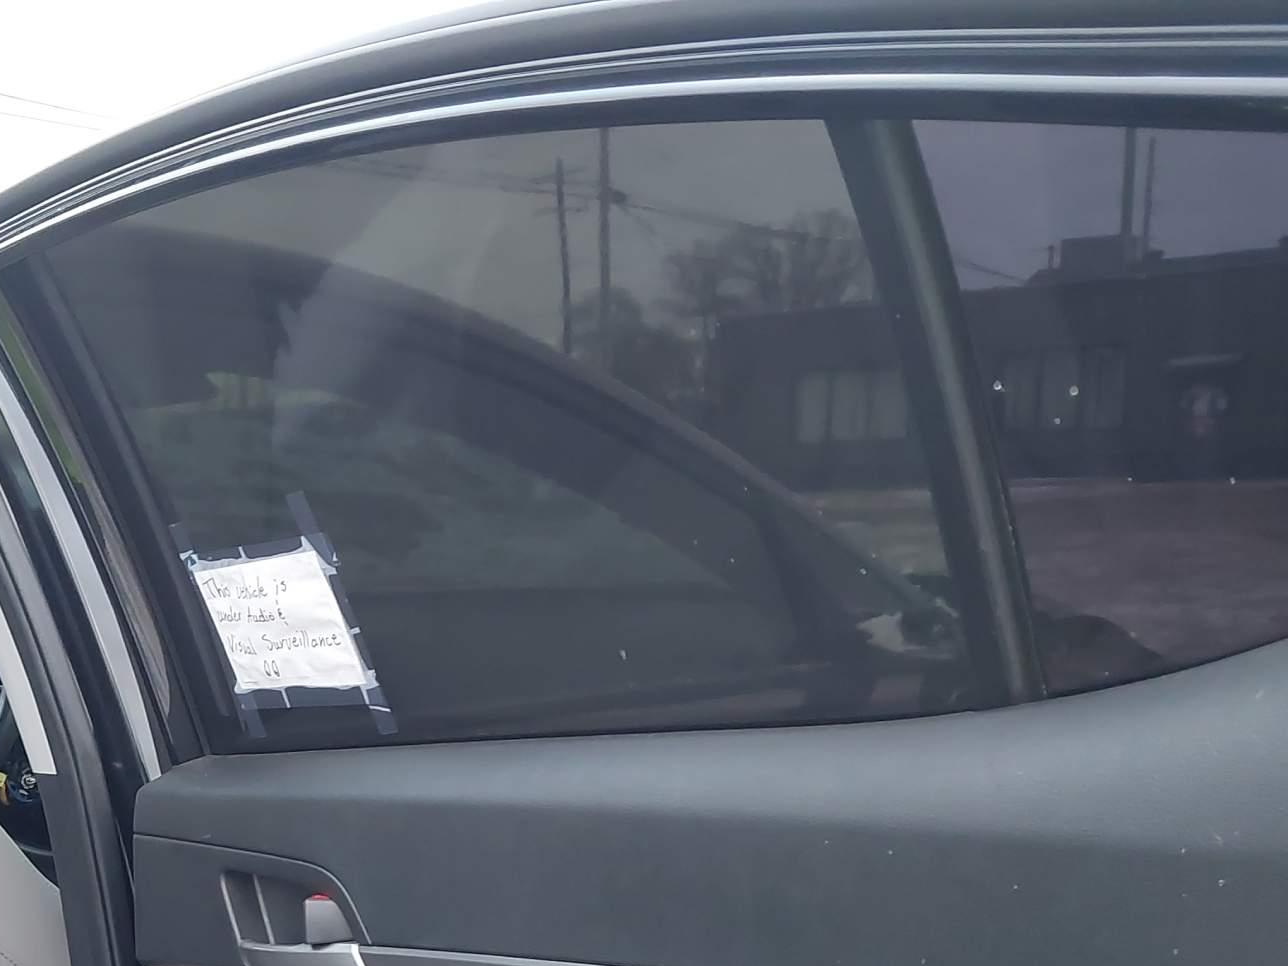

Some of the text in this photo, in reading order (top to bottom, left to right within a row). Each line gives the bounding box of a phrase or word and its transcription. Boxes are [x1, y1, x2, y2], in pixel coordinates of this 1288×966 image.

[202, 577, 231, 599] This
[273, 578, 287, 596] is
[261, 630, 342, 652] Surveillance
